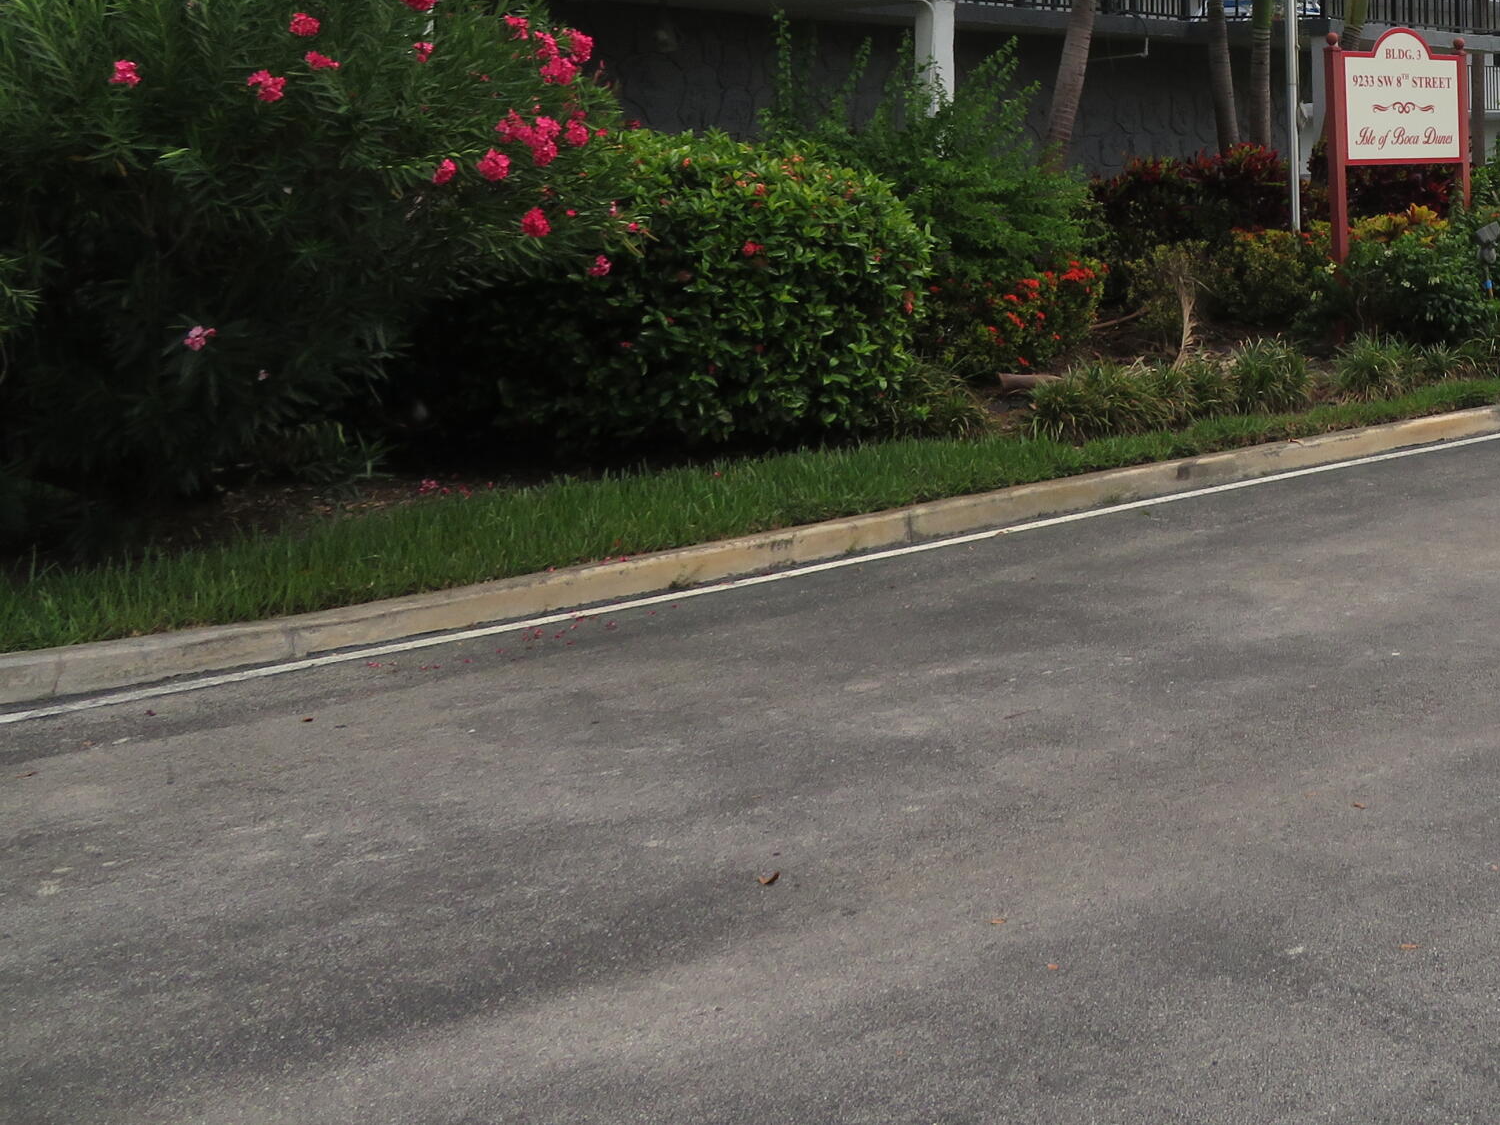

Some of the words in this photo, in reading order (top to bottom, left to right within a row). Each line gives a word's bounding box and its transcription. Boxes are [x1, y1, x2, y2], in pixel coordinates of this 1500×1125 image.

[1385, 48, 1415, 60] BLDG.
[1417, 49, 1422, 60] 3
[1352, 74, 1375, 88] 9233
[1377, 75, 1395, 88] SW
[1411, 76, 1452, 89] STREET
[1355, 126, 1376, 146] Isle
[1378, 129, 1392, 150] of
[1391, 126, 1419, 145] Boca
[1422, 126, 1453, 145] Dunes
